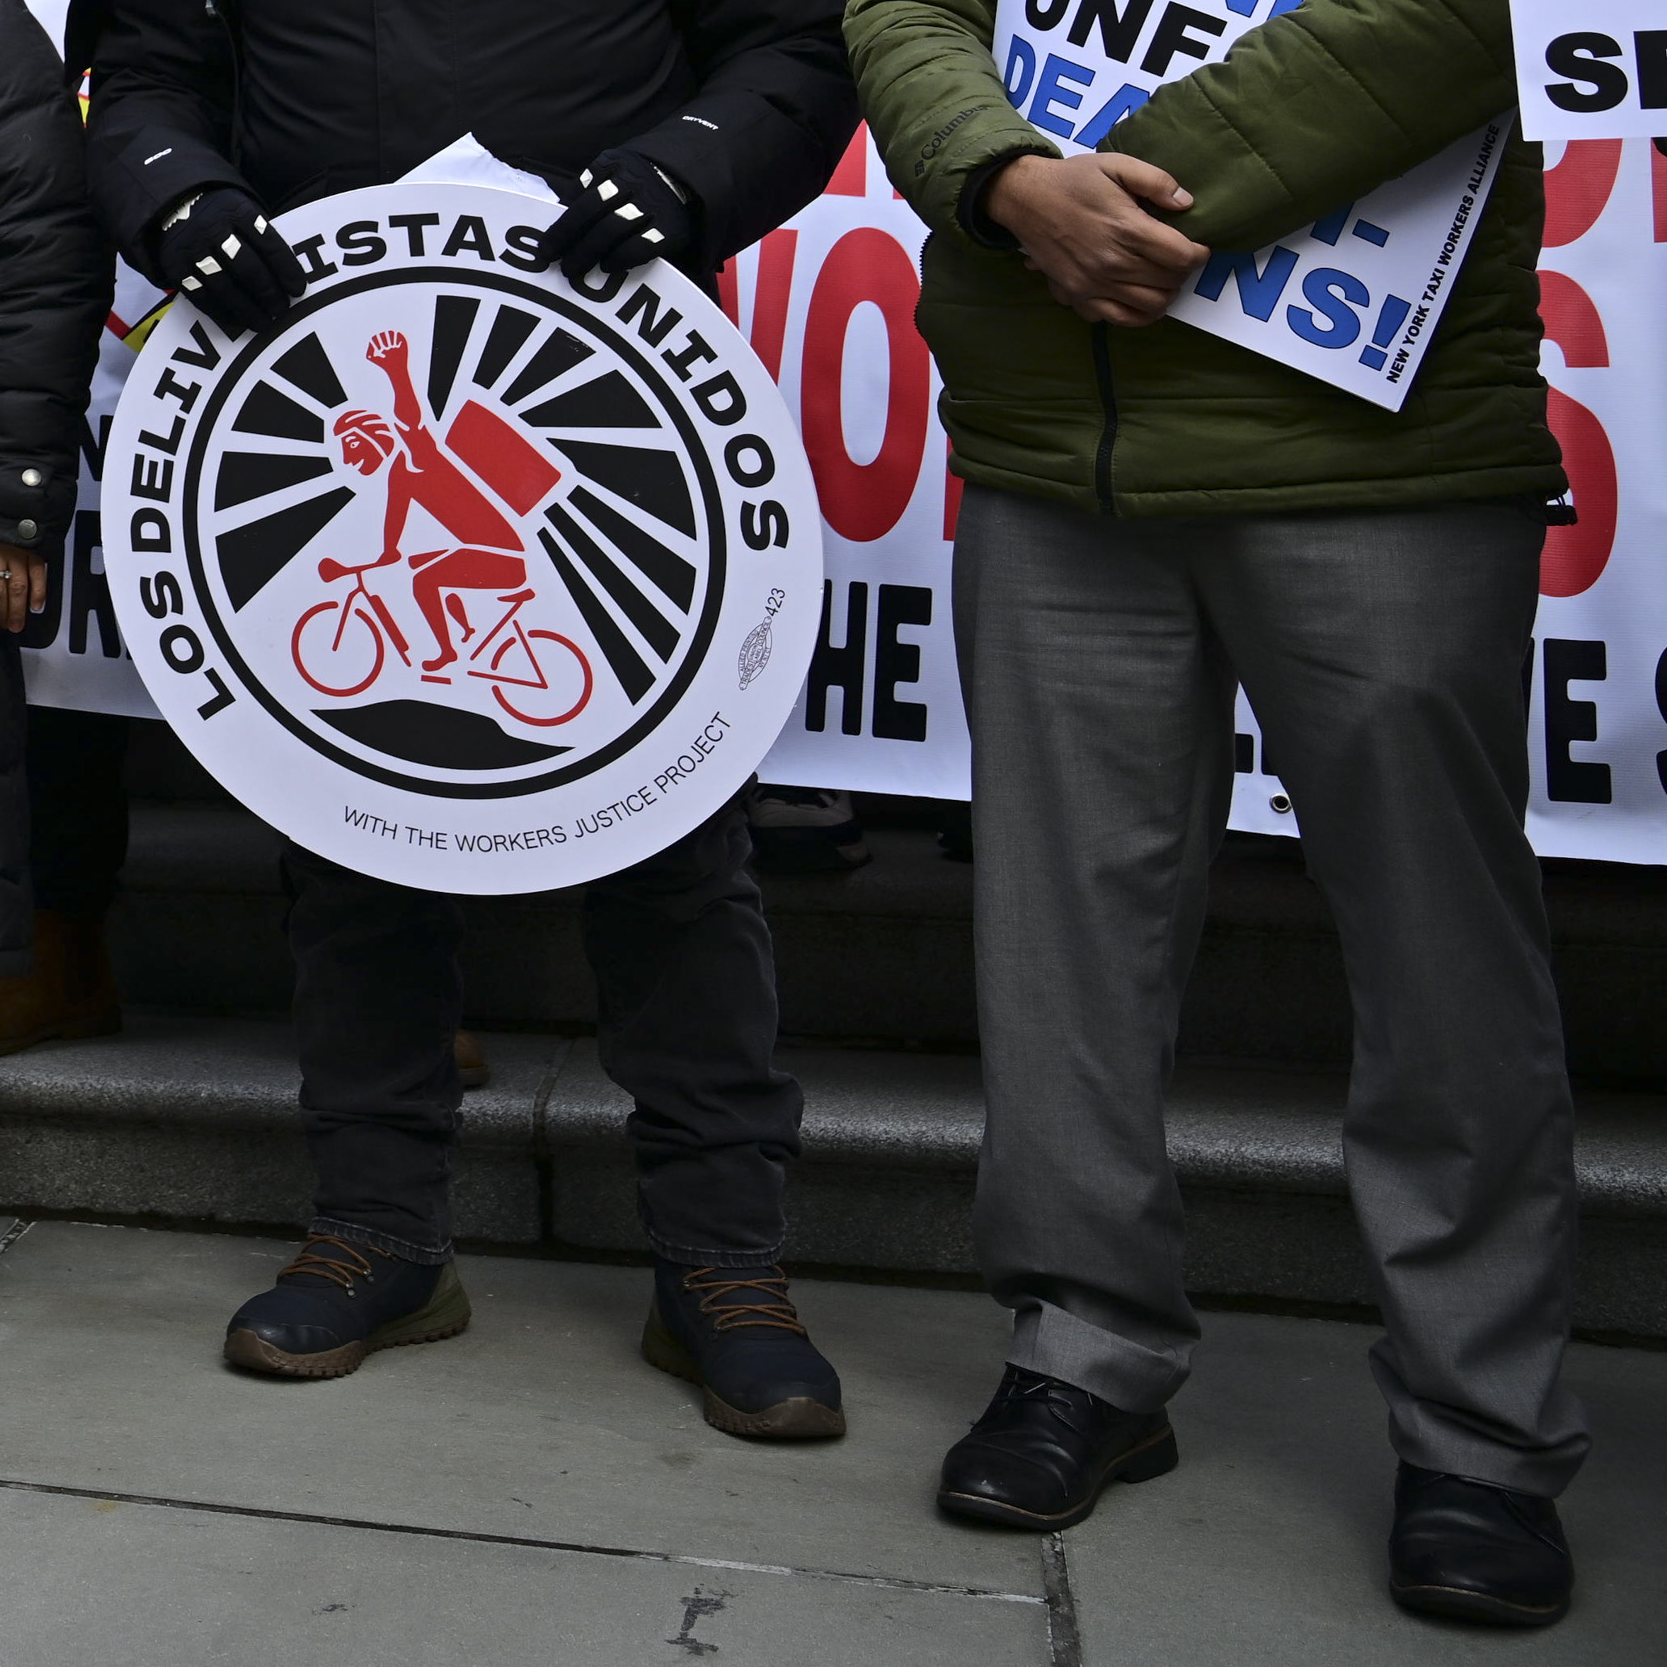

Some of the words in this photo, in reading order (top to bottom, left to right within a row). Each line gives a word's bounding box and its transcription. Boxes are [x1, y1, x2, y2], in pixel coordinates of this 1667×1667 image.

[1386, 349, 1410, 384] NEW
[1402, 304, 1430, 345] YORK
[1422, 268, 1445, 303] TAXI
[1438, 196, 1474, 266] WORKERS
[1467, 124, 1499, 195] ALLIANCE
[139, 572, 236, 722] LOS
[578, 259, 789, 553] UNIDOS
[765, 588, 785, 616] 423
[343, 804, 399, 840] WITH
[405, 826, 449, 851] THE
[453, 826, 568, 854] WORKERS
[572, 785, 655, 840] JUSTICE
[653, 711, 733, 792] PROJECT
